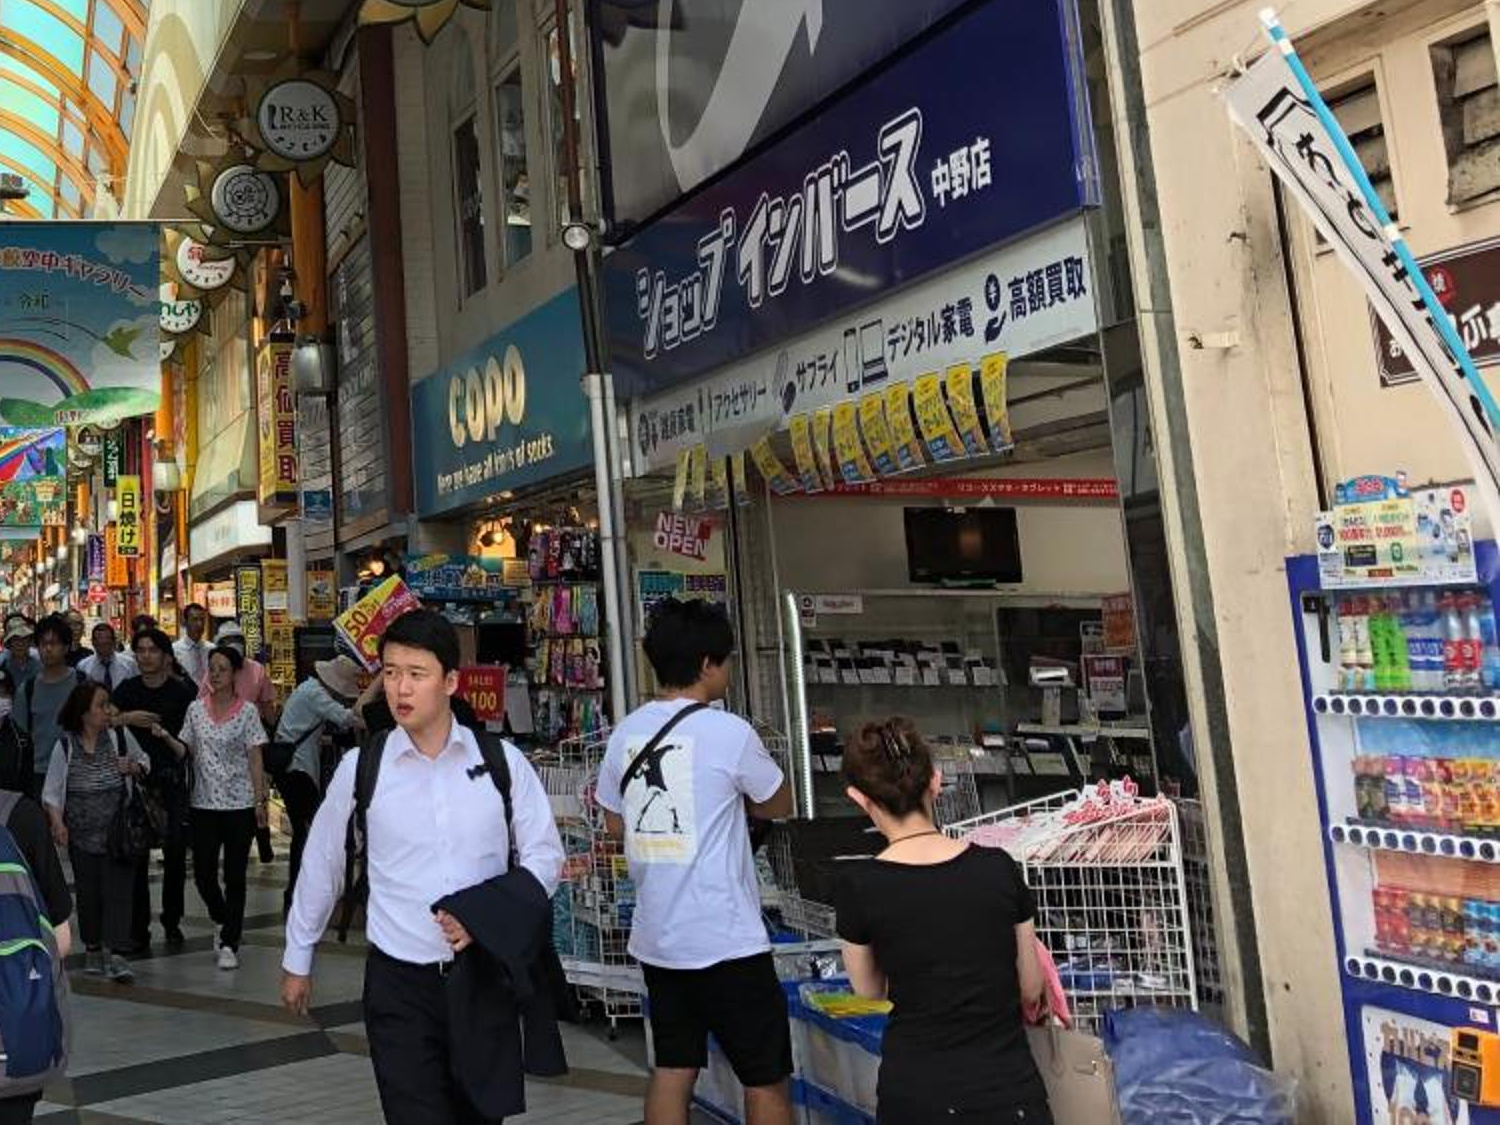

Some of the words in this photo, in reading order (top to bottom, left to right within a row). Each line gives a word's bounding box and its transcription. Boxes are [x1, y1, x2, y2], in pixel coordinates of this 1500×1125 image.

[930, 136, 993, 210] 中野店
[635, 106, 925, 360] ショップインバース
[1007, 254, 1088, 322] 高額買取
[887, 296, 977, 356] デジタル家電
[713, 380, 768, 425] アクセサリー
[120, 491, 139, 546] 日焼け
[654, 530, 709, 557] OPEN
[657, 512, 703, 537] NEW
